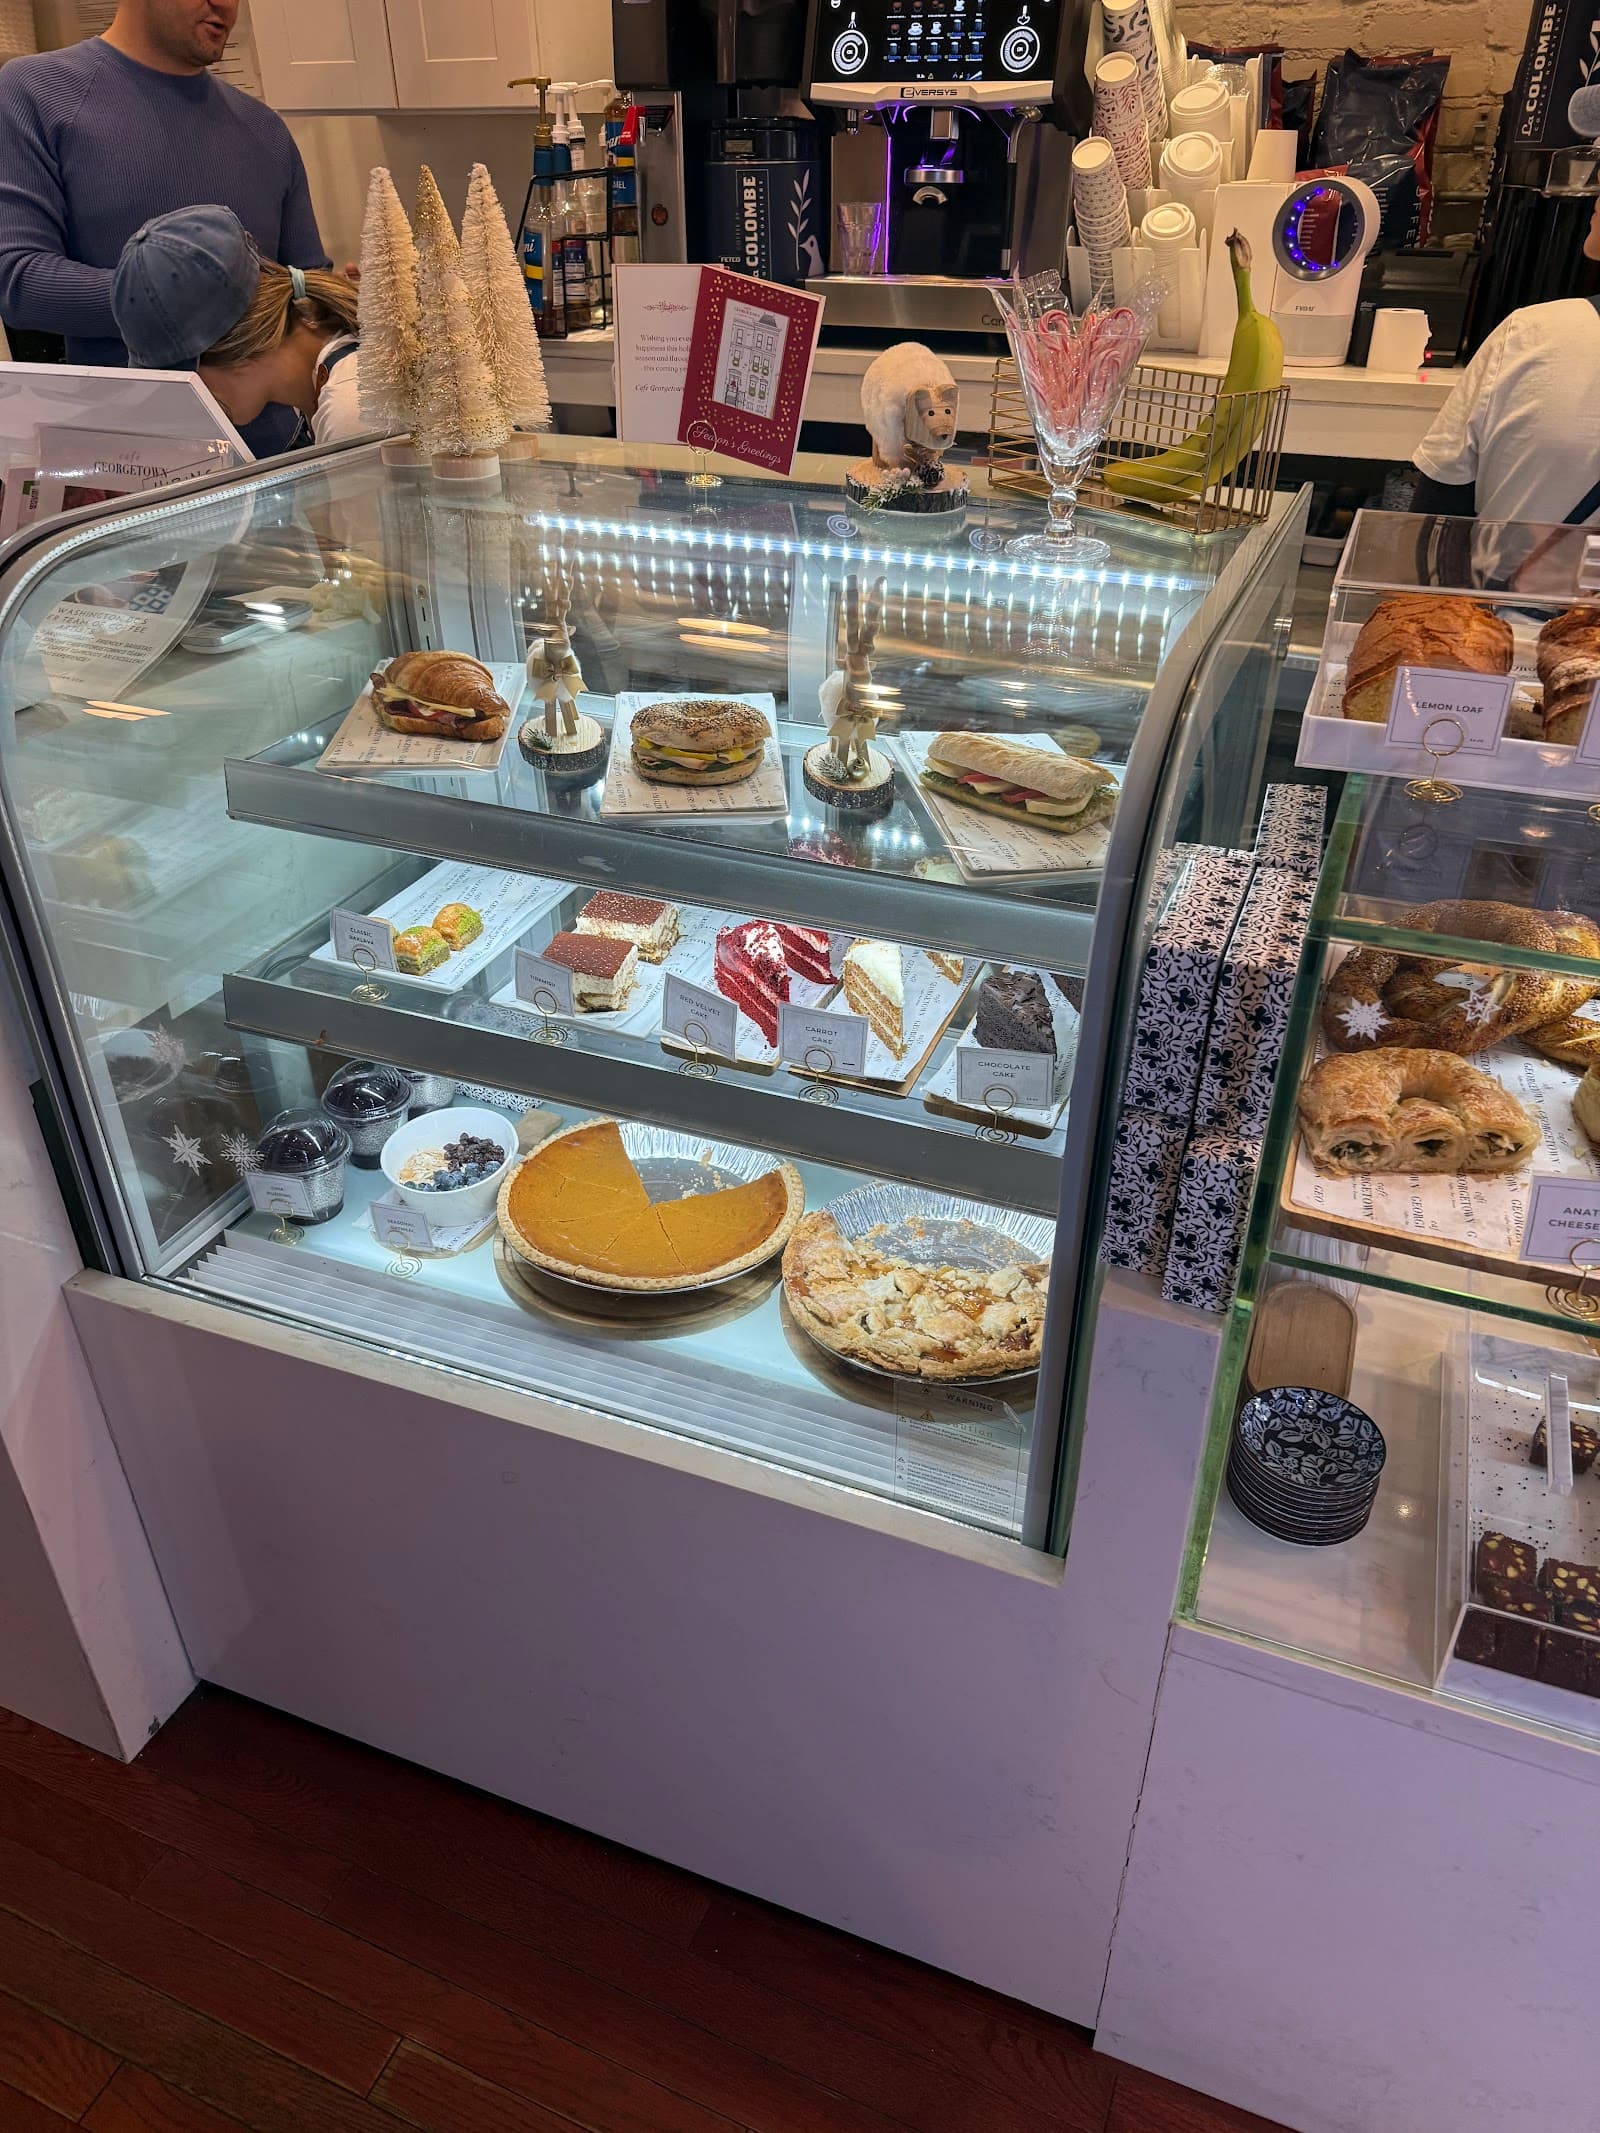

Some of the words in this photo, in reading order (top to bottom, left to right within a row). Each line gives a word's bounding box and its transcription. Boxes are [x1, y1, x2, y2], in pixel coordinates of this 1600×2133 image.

[1525, 3, 1557, 112] COLOMBE
[743, 176, 759, 267] COLOMBE
[737, 440, 781, 466] Greetings
[94, 461, 168, 479] GEORGETOWN
[108, 623, 146, 634] COFEE
[1416, 701, 1453, 711] LEMON
[1456, 705, 1485, 714] LOAF
[679, 993, 694, 1006] RED
[694, 1001, 721, 1017] VELVET
[690, 1008, 708, 1020] CAKE
[805, 1026, 839, 1037] CARROT
[811, 1036, 833, 1045] CAKE
[978, 1061, 1031, 1071] CHOCOLATE
[992, 1071, 1017, 1079] CAKE
[947, 1392, 994, 1412] WARNING
